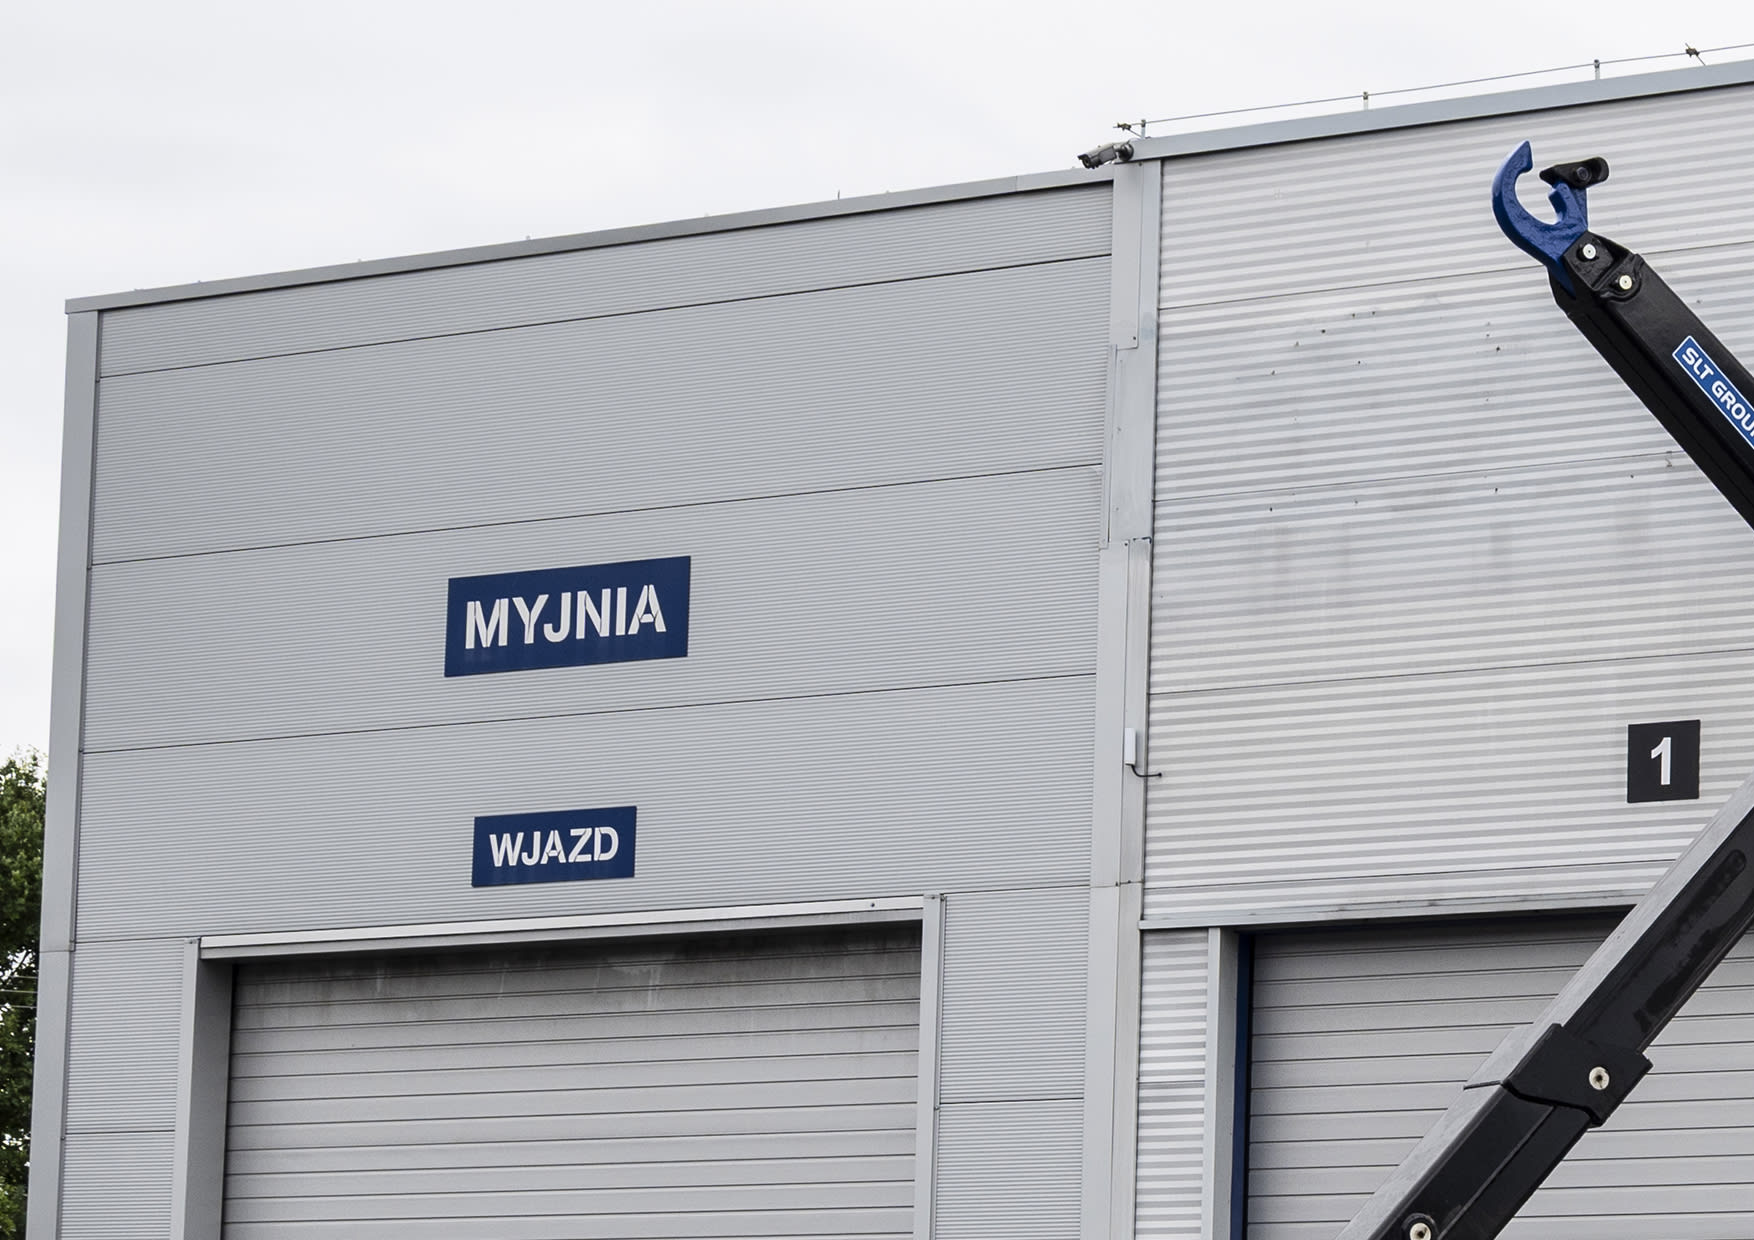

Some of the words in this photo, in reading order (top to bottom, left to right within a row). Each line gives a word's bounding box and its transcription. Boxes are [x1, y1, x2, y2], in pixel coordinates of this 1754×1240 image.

[1682, 347, 1714, 380] SLT
[465, 584, 667, 649] MYJNIA
[1650, 736, 1672, 786] 1
[489, 826, 619, 867] WJAZD
